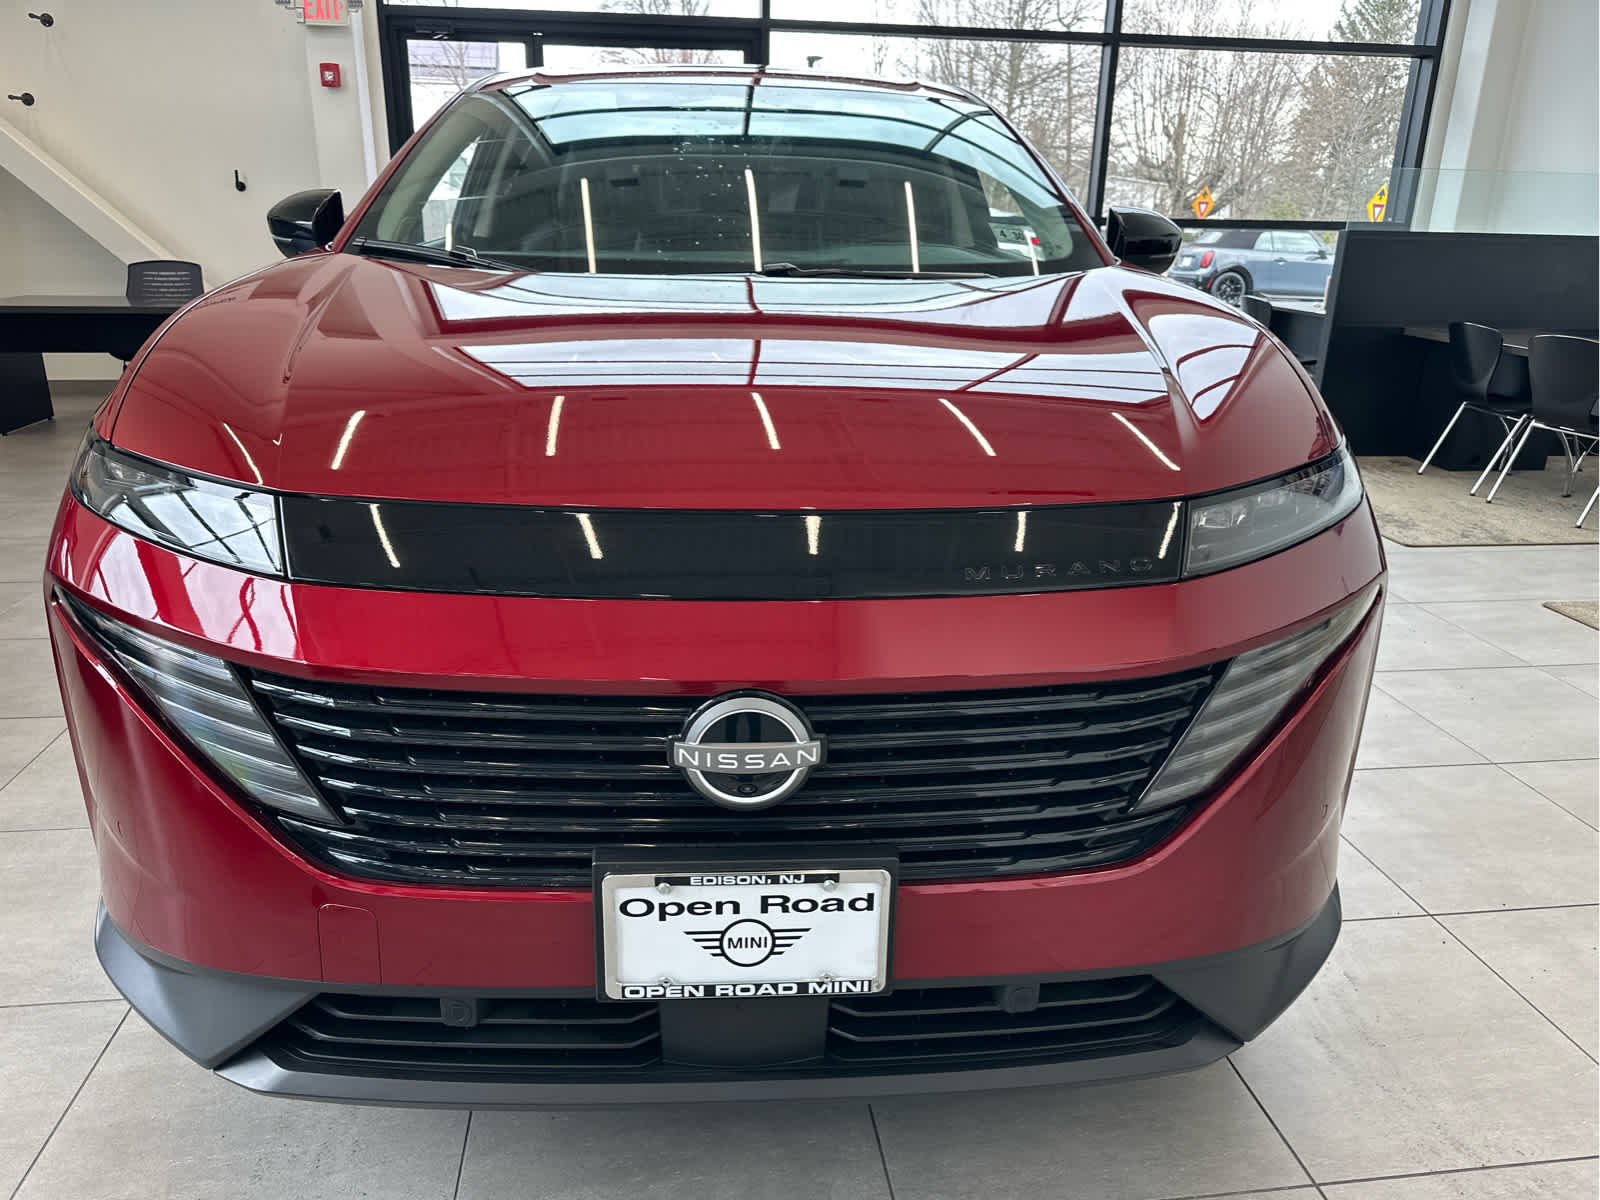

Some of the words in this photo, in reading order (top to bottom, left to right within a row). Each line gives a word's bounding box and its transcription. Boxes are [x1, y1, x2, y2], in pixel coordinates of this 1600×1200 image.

[964, 559, 1153, 581] MURANO
[679, 747, 817, 769] NISSAN
[690, 875, 772, 886] EDISON,
[779, 874, 806, 884] NJ
[619, 898, 741, 921] Open
[760, 893, 875, 914] Road
[727, 936, 768, 949] MINI
[624, 985, 705, 998] OPEN
[715, 983, 798, 996] ROAD
[808, 980, 873, 993] MINI
